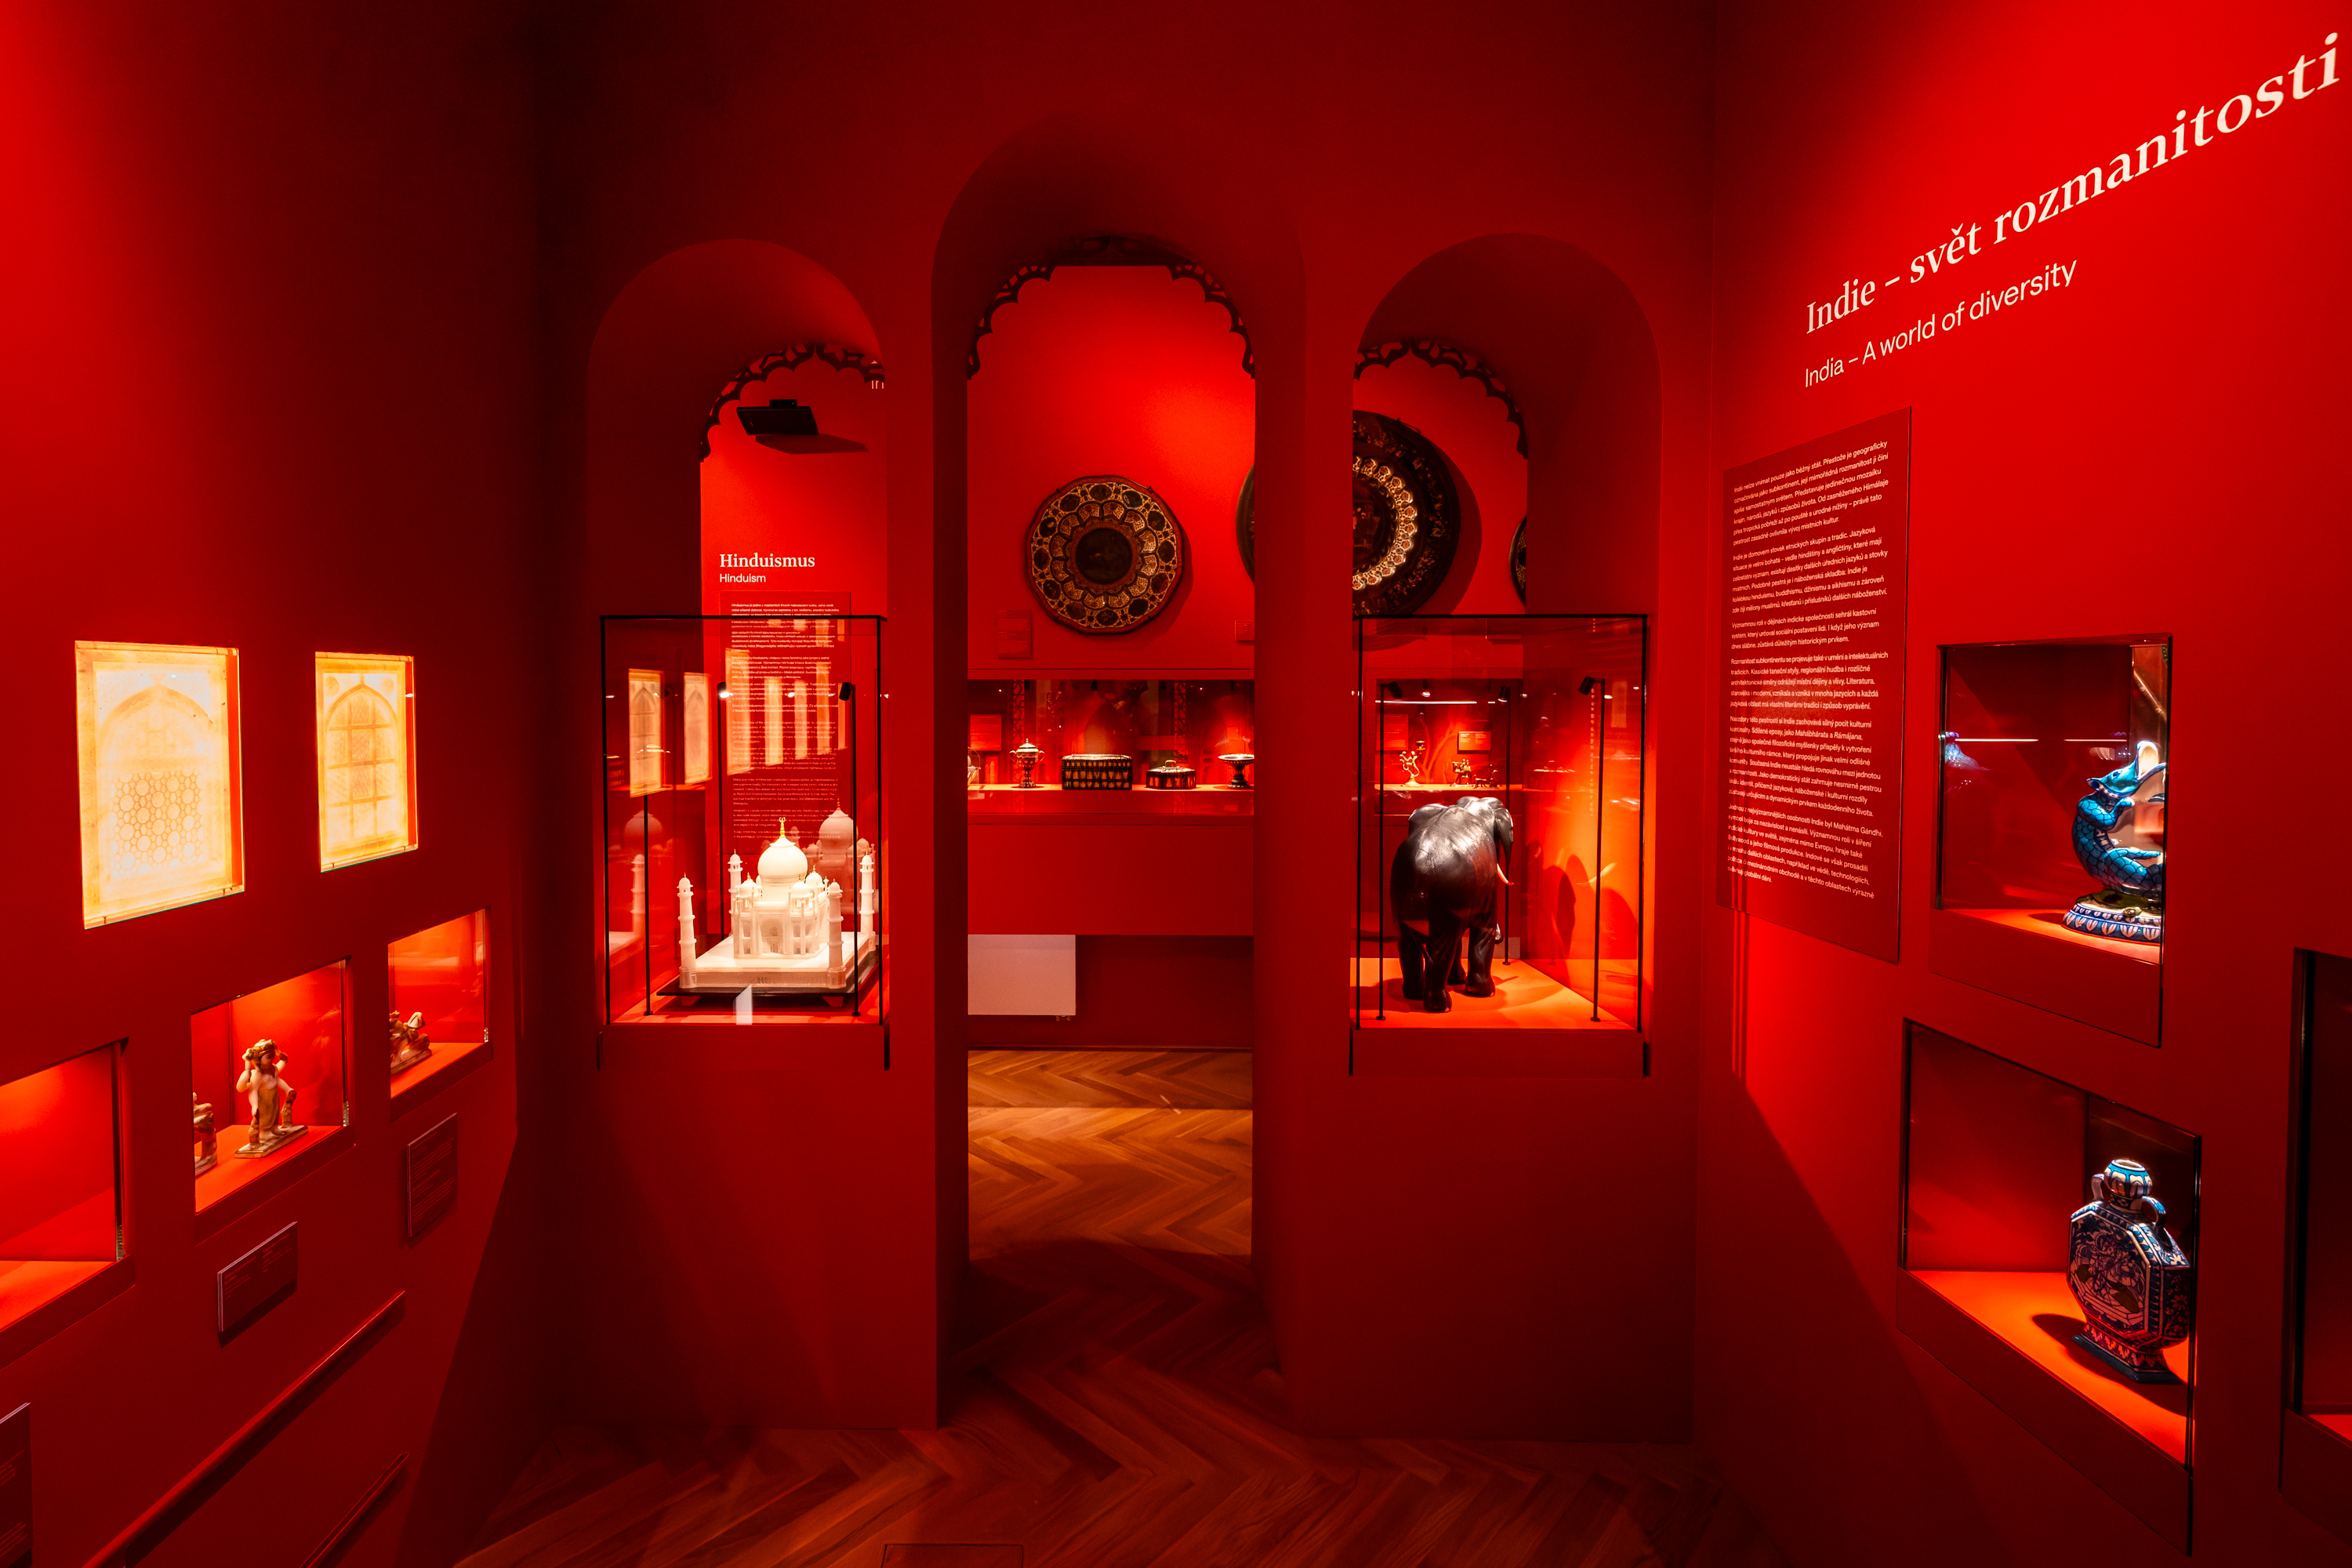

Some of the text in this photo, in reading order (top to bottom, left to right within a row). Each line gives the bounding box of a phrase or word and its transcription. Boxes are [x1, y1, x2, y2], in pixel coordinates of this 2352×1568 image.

[1806, 278, 1876, 334] Indie
[1910, 223, 1982, 284] svět
[1993, 32, 2340, 245] rozmanitosti
[1805, 357, 1845, 388] India
[1862, 340, 1877, 365] A
[1879, 313, 1936, 358] world
[1941, 300, 1966, 332] of
[1969, 260, 2078, 321] diversity
[1872, 456, 1877, 464] ji
[1869, 536, 1882, 546] mají
[1868, 550, 1888, 559] stovky
[719, 552, 815, 568] Hinduismus
[1861, 565, 1867, 574] je
[719, 573, 766, 583] Hinduism
[1855, 770, 1881, 780] jednotou
[1859, 784, 1882, 793] pestrou
